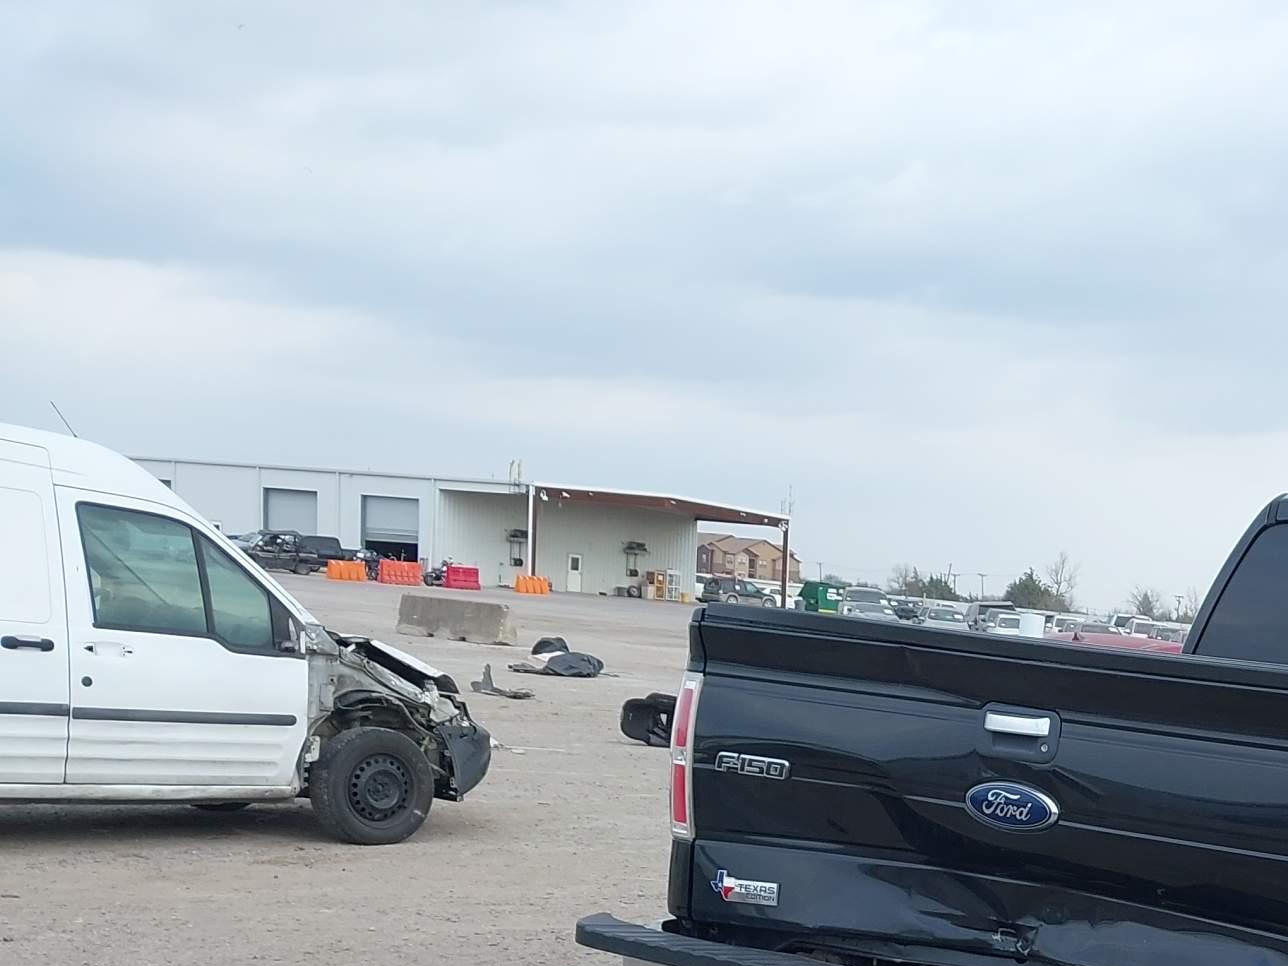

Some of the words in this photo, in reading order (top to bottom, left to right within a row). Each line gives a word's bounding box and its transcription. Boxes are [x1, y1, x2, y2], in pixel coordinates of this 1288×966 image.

[714, 751, 790, 779] F-150
[982, 789, 1032, 821] Ford
[736, 883, 776, 895] TEXAS
[745, 892, 775, 902] EDITION
